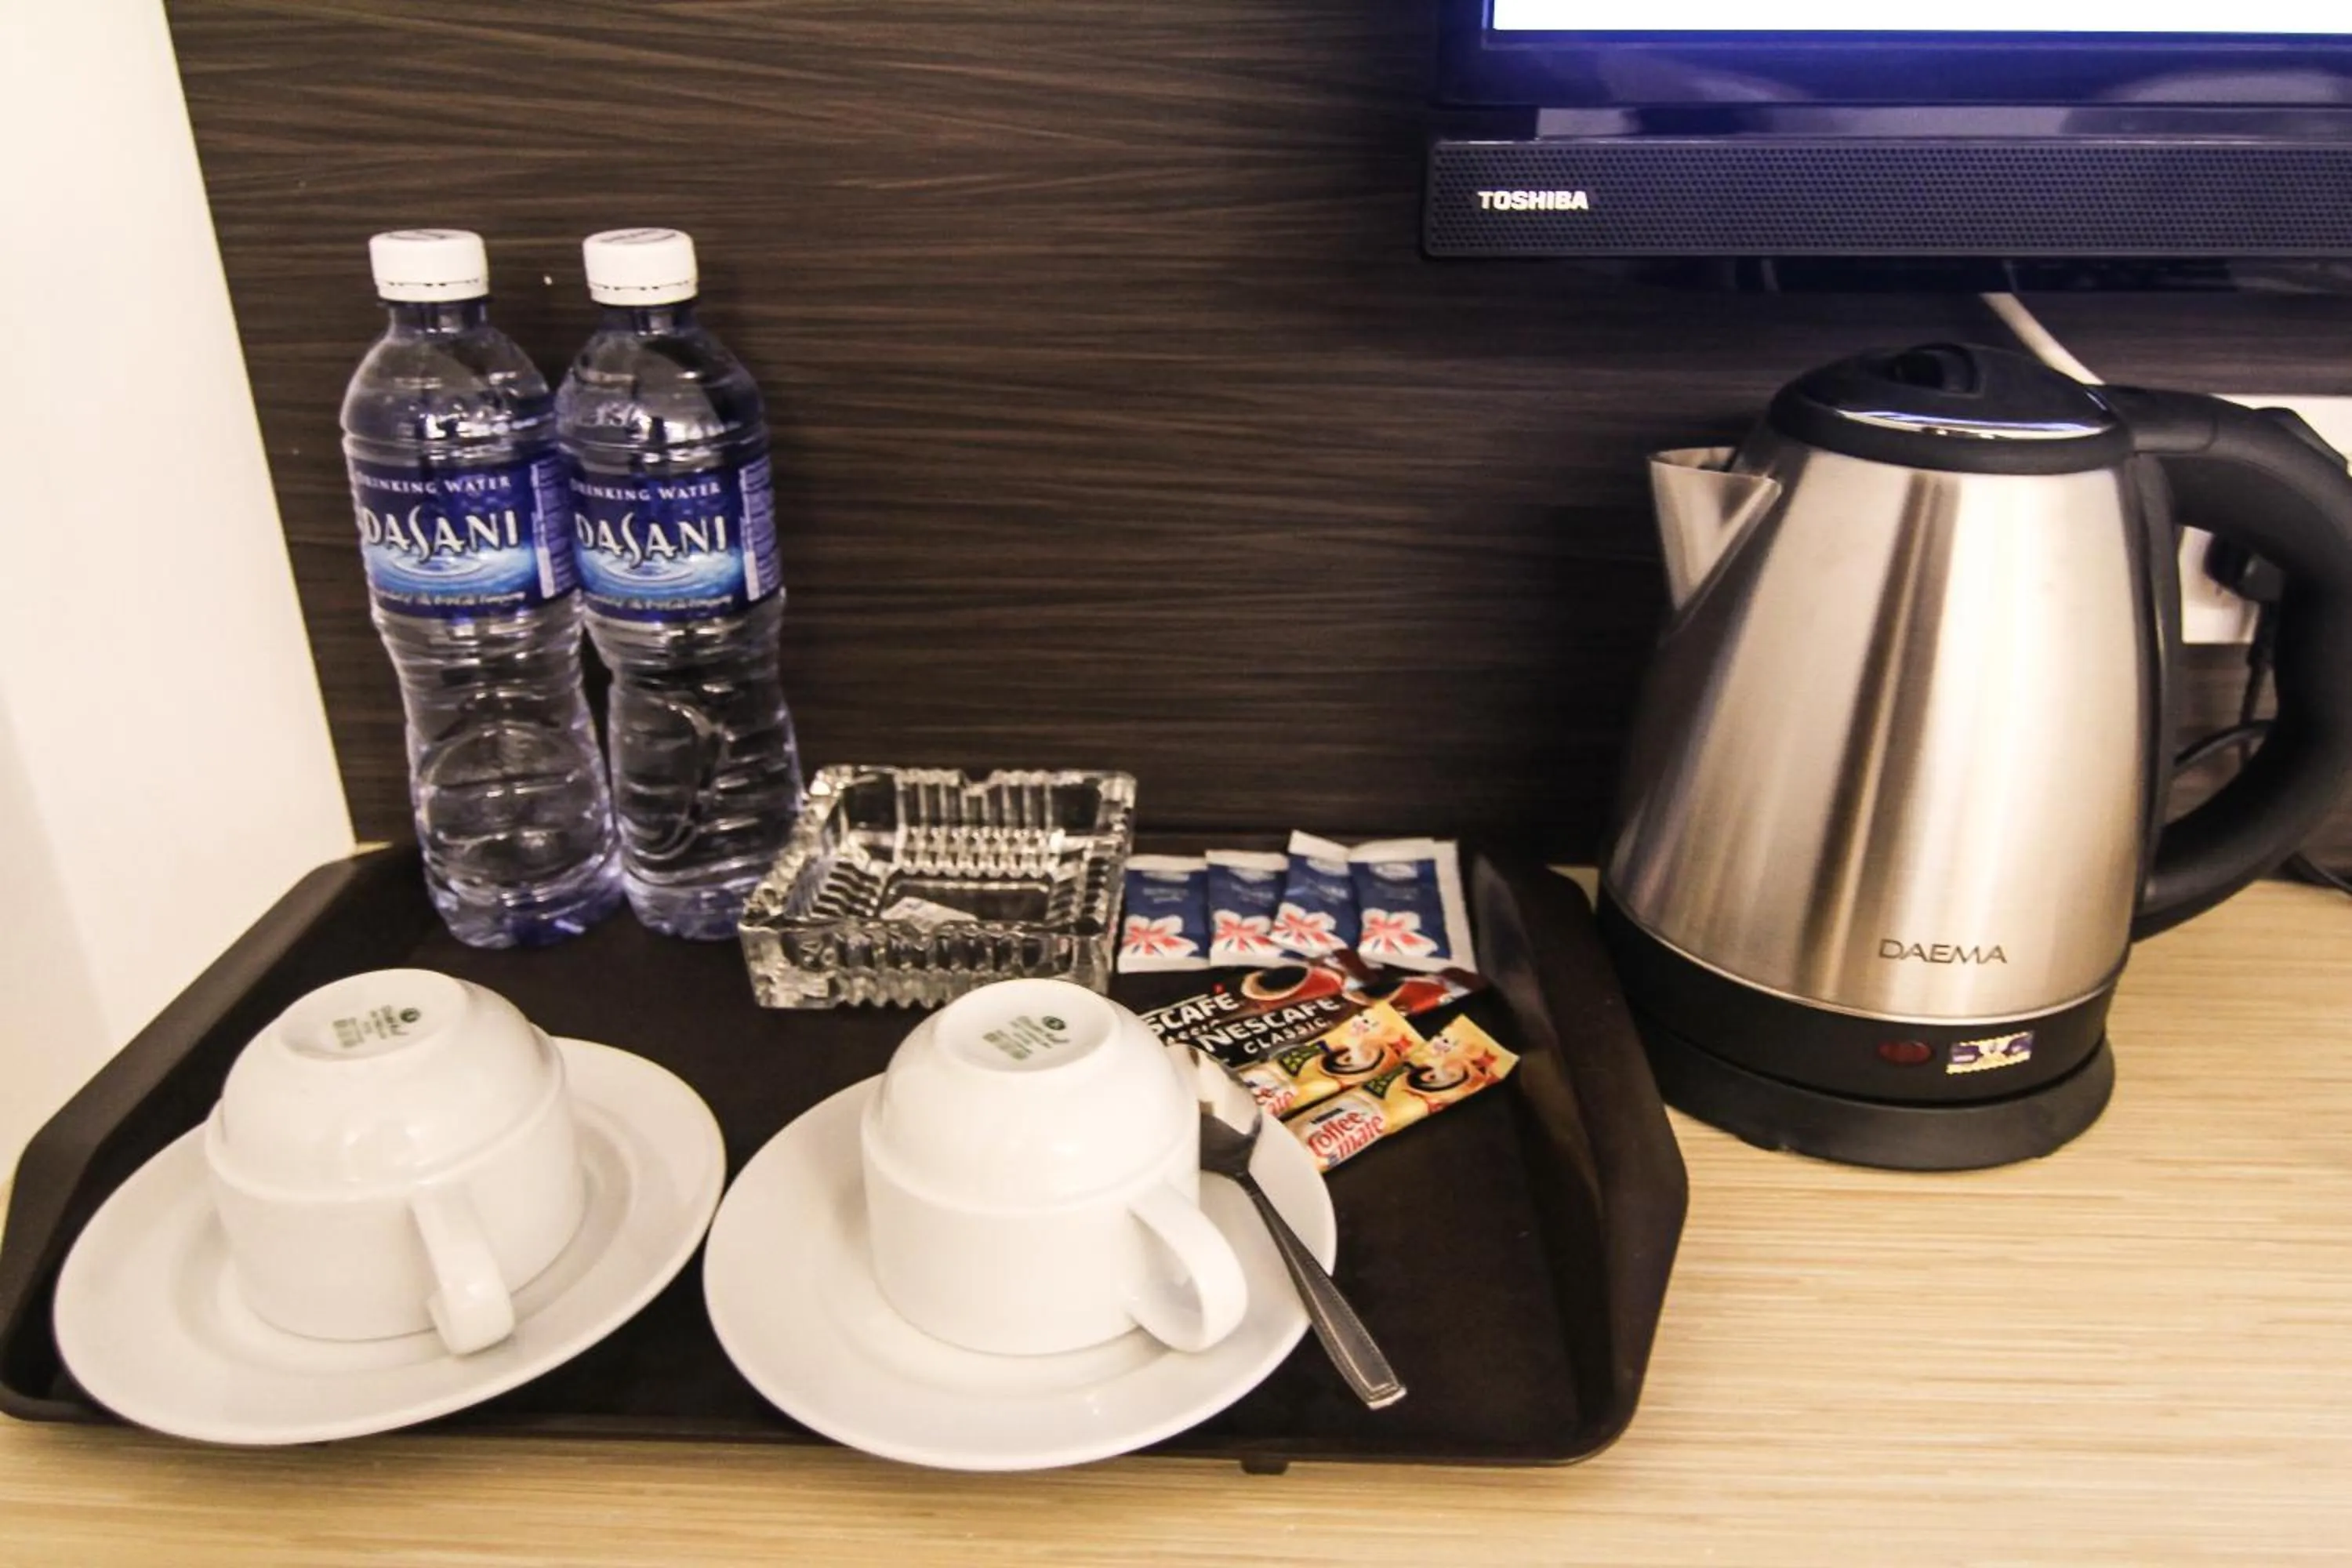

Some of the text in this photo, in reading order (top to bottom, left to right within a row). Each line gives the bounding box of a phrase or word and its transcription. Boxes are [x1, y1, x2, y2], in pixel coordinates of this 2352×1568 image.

[1477, 191, 1589, 211] TOSHIBA
[444, 476, 511, 493] WATER
[657, 481, 721, 500] WATER
[361, 505, 519, 563] DASANI
[575, 511, 727, 568] DASANI
[1878, 938, 2007, 964] DAEMA
[1243, 1017, 1328, 1054] CLASSIC
[1307, 1111, 1363, 1158] Coffee
